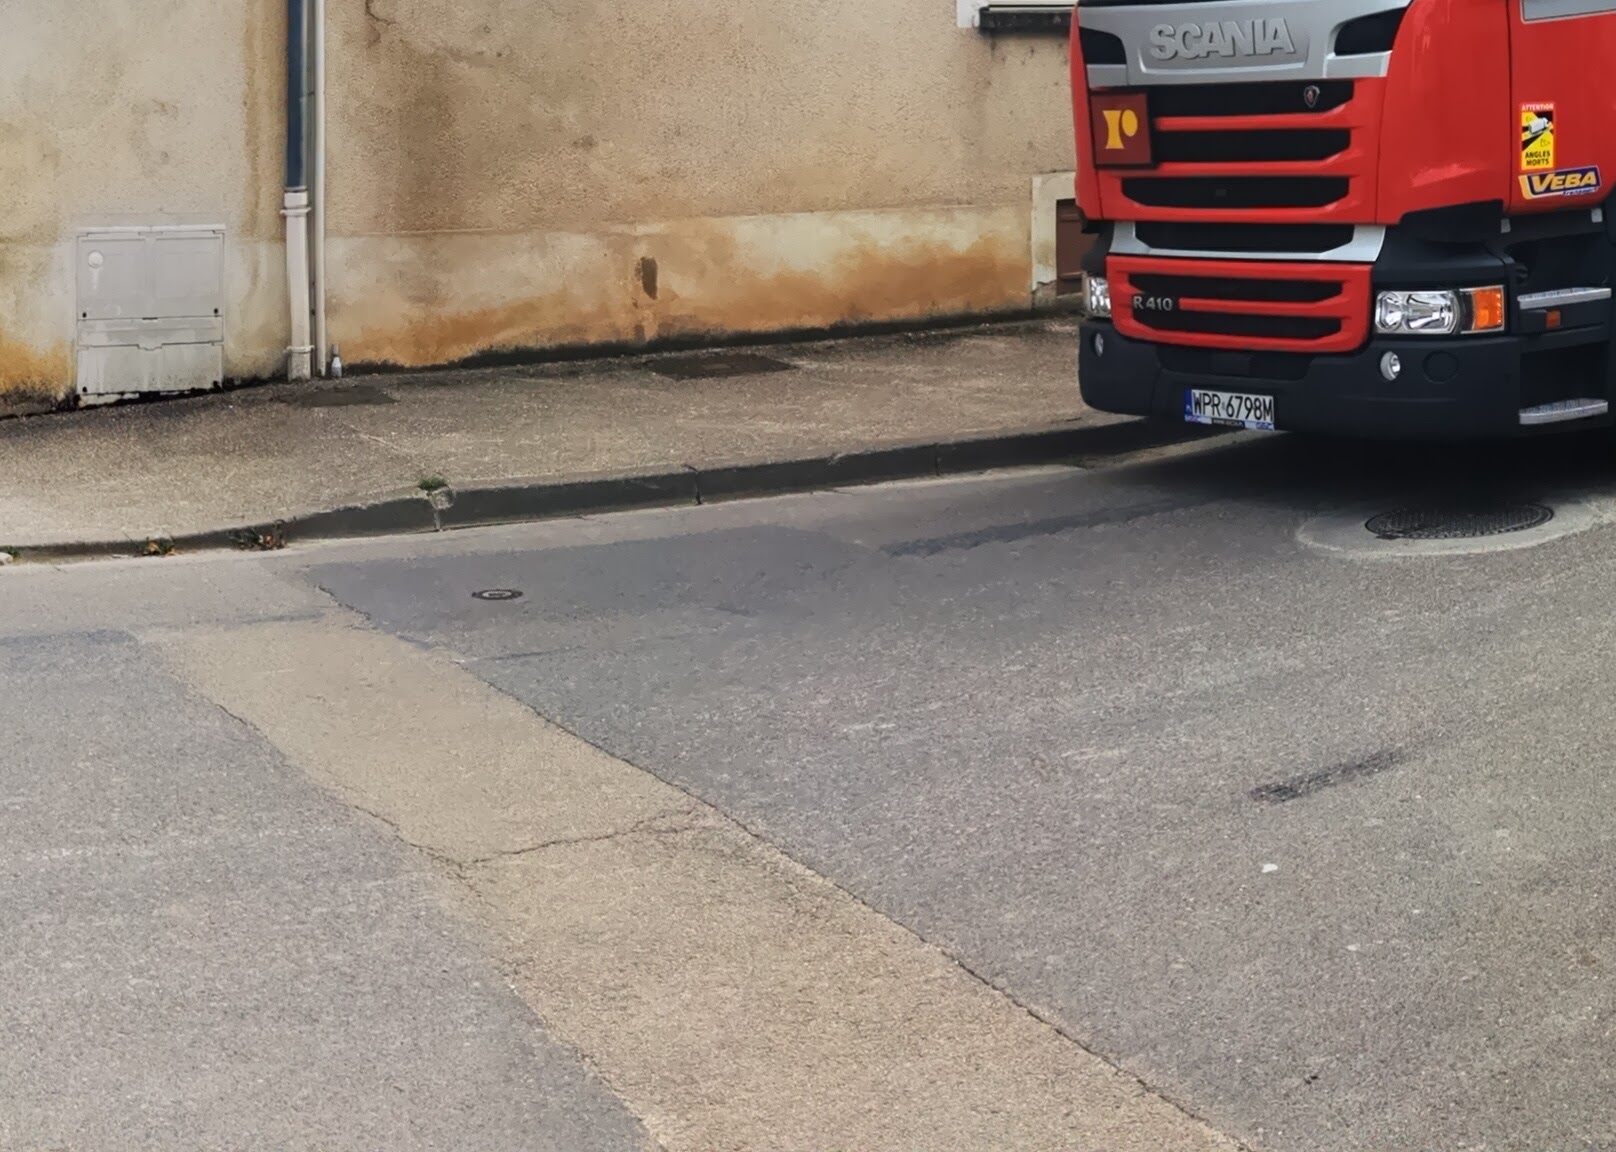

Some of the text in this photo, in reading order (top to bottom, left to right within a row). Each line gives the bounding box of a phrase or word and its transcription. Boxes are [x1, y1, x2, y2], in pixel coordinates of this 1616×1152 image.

[1149, 17, 1296, 61] SCANIA
[1521, 103, 1554, 111] ATTENTION
[1525, 151, 1550, 159] ANGLES
[1531, 171, 1597, 193] VEBA
[1133, 296, 1173, 311] R 410
[1193, 392, 1273, 421] WPR 6798M
